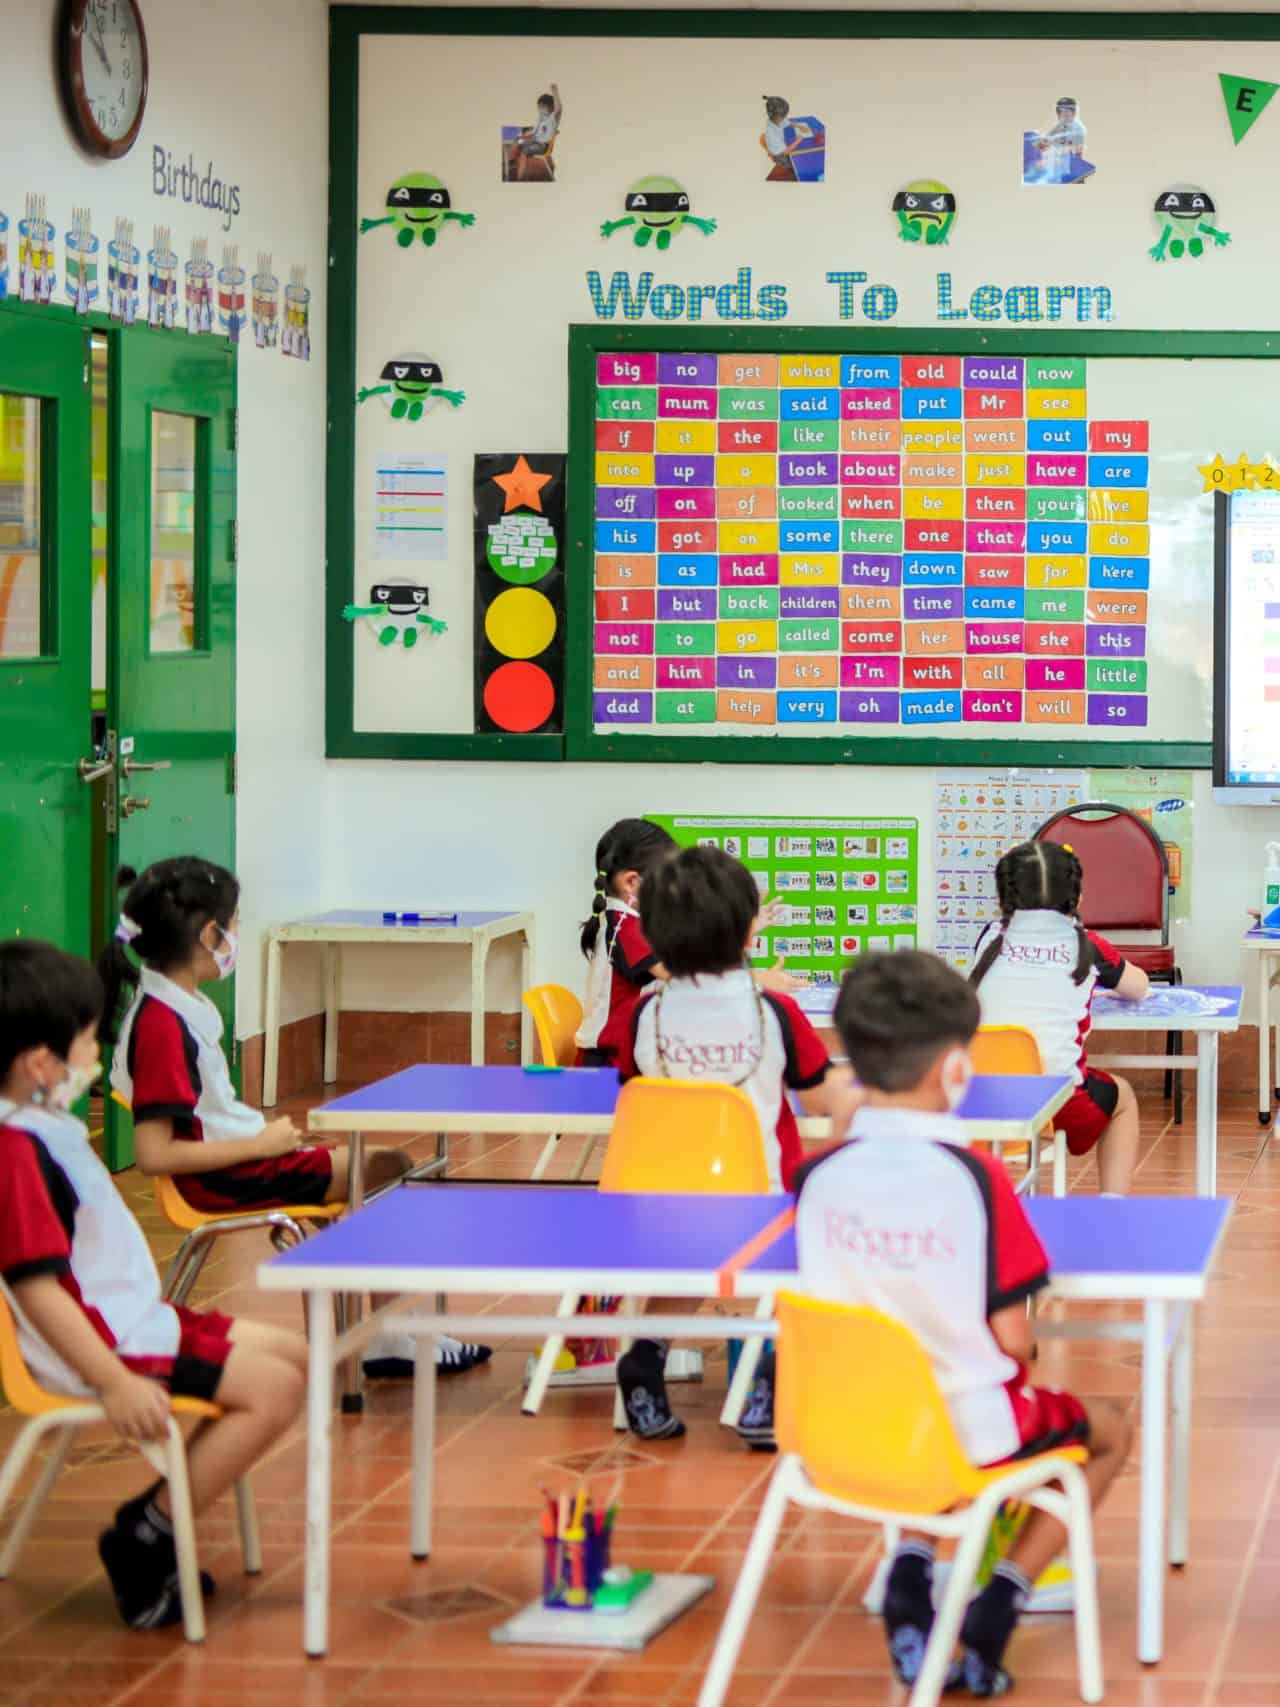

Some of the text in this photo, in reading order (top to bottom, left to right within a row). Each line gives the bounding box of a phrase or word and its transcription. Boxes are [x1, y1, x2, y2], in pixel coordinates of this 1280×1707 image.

[153, 145, 240, 232] Birthdays
[586, 267, 1116, 321] Words To Learn
[613, 361, 641, 382] big
[676, 365, 698, 377] no
[735, 367, 761, 383] get
[788, 363, 832, 378] what
[847, 363, 890, 384] from
[916, 363, 945, 379] old
[969, 365, 1018, 381] could
[1037, 369, 1073, 380] now
[611, 399, 643, 411] can
[665, 398, 710, 411] mum
[731, 400, 766, 411] was
[791, 396, 828, 412] said
[847, 396, 892, 411] asked
[918, 397, 947, 415] put
[980, 394, 1006, 410] Mr
[1042, 399, 1070, 410] see
[618, 430, 632, 449] if
[679, 431, 692, 445] it
[734, 428, 762, 444] the
[793, 427, 825, 443] like
[850, 427, 891, 442] their
[904, 430, 960, 450] people
[973, 431, 1016, 443] went
[1042, 430, 1072, 443] out
[1105, 432, 1132, 449] my
[608, 463, 640, 476] into
[673, 466, 695, 483] up
[789, 461, 828, 477] look
[844, 461, 896, 477] about
[909, 463, 956, 477] make
[976, 463, 1011, 482] just
[1035, 461, 1077, 477] have
[1104, 467, 1131, 478] are
[1212, 469, 1224, 483] 0
[1240, 468, 1247, 481] 1
[1264, 468, 1273, 481] 2
[615, 494, 637, 513] off
[674, 499, 697, 511] on
[737, 494, 756, 515] of
[781, 495, 835, 511] looked
[847, 494, 894, 510] when
[922, 495, 944, 510] be
[975, 495, 1015, 511] then
[613, 528, 638, 544] his
[672, 531, 703, 549] got
[738, 535, 758, 545] an
[786, 531, 832, 543] some
[850, 527, 894, 544] there
[918, 531, 950, 543] one
[976, 528, 1014, 545] that
[1040, 533, 1073, 550] you
[1108, 530, 1130, 546] do
[618, 564, 633, 578] is
[677, 566, 697, 577] as
[732, 561, 766, 577] had
[793, 561, 824, 576] Mrs
[852, 561, 890, 583] they
[908, 559, 956, 575] down
[978, 568, 1009, 579] saw
[1042, 563, 1069, 585] for
[1102, 564, 1134, 578] here
[621, 595, 629, 612] I
[672, 596, 702, 612] but
[727, 594, 769, 609] back
[781, 596, 837, 609] children
[847, 593, 892, 609] them
[913, 596, 953, 610] time
[971, 598, 1017, 609] came
[1041, 601, 1067, 613] me
[1096, 603, 1137, 615] were
[609, 633, 639, 646] not
[675, 633, 694, 647] to
[736, 632, 758, 649] go
[785, 627, 830, 641] called
[848, 632, 894, 643] come
[921, 631, 948, 645] her
[969, 630, 1021, 645] house
[1039, 631, 1069, 646] she
[1099, 632, 1132, 647] this
[607, 665, 640, 680] and
[668, 663, 703, 679] him
[738, 664, 755, 679] in
[795, 663, 821, 678] it's
[854, 663, 885, 678] I'm
[912, 664, 953, 680] with
[982, 664, 1005, 680] all
[1044, 666, 1065, 681] he
[1096, 667, 1137, 683] little
[606, 698, 640, 714] dad
[676, 701, 695, 714] at
[730, 698, 761, 717] help
[788, 702, 825, 718] very
[858, 697, 881, 713] oh
[907, 699, 954, 715] made
[971, 698, 1013, 713] don't
[1039, 699, 1072, 714] will
[1107, 706, 1127, 717] so
[1001, 942, 1071, 965] egent's
